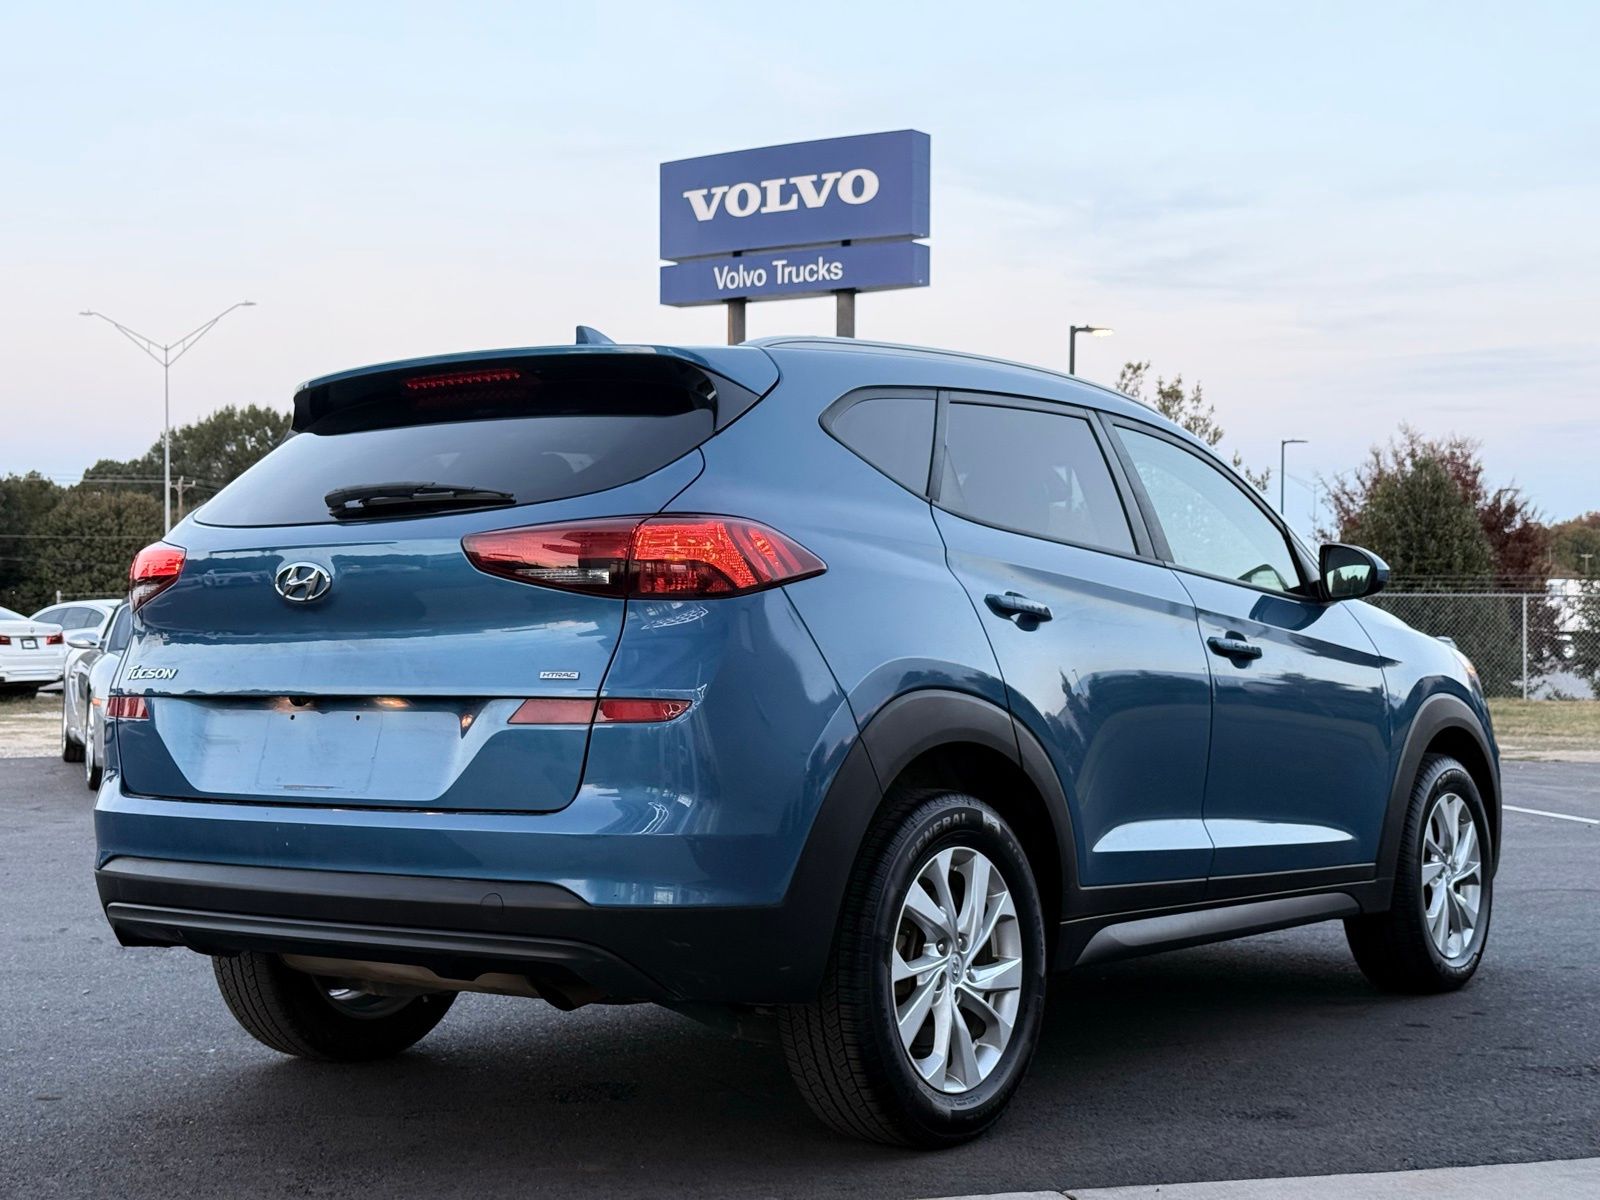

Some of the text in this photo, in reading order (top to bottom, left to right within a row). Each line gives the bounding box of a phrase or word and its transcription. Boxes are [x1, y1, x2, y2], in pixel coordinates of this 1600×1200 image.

[683, 168, 880, 222] VOLVO
[713, 256, 843, 290] Volvo Trucks
[127, 665, 178, 680] TUCSON
[541, 671, 577, 679] HTRAC
[907, 812, 968, 862] GENERAL
